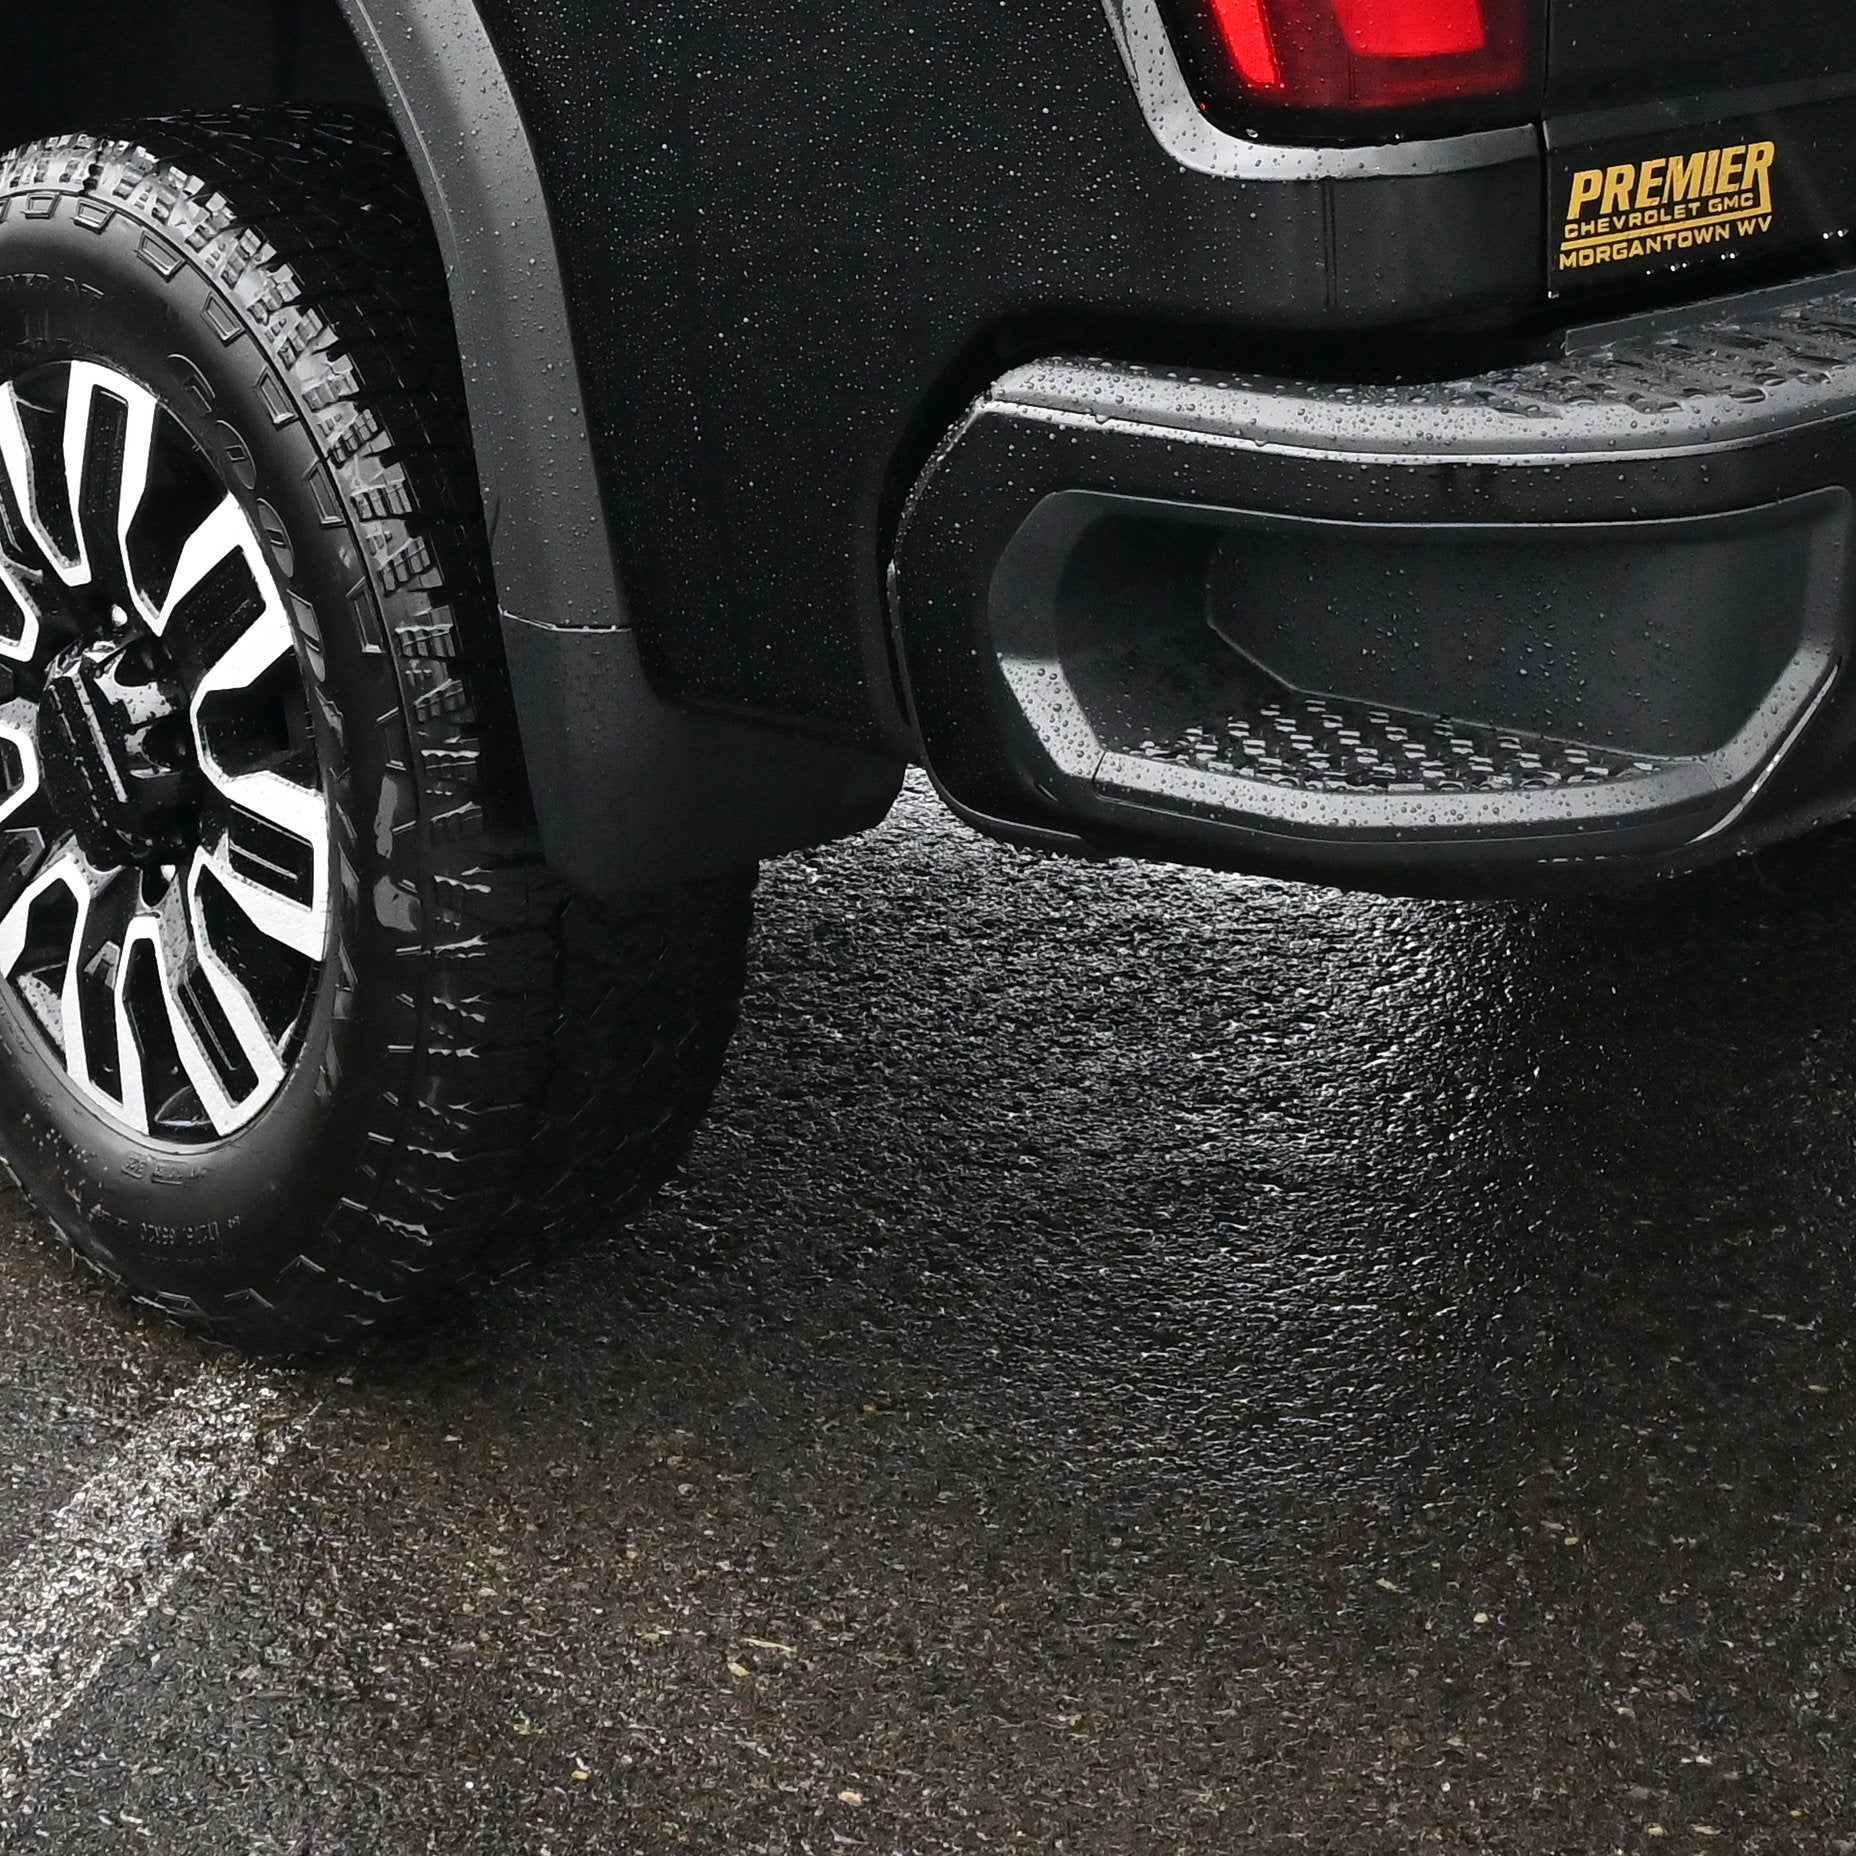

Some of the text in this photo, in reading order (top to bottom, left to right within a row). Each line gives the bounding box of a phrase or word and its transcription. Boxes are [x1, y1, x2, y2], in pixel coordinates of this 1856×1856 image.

[1566, 141, 1775, 220] PREMIER
[1559, 215, 1772, 270] MORGANTOWN WV
[1564, 192, 1754, 239] CHEVROLET GMC
